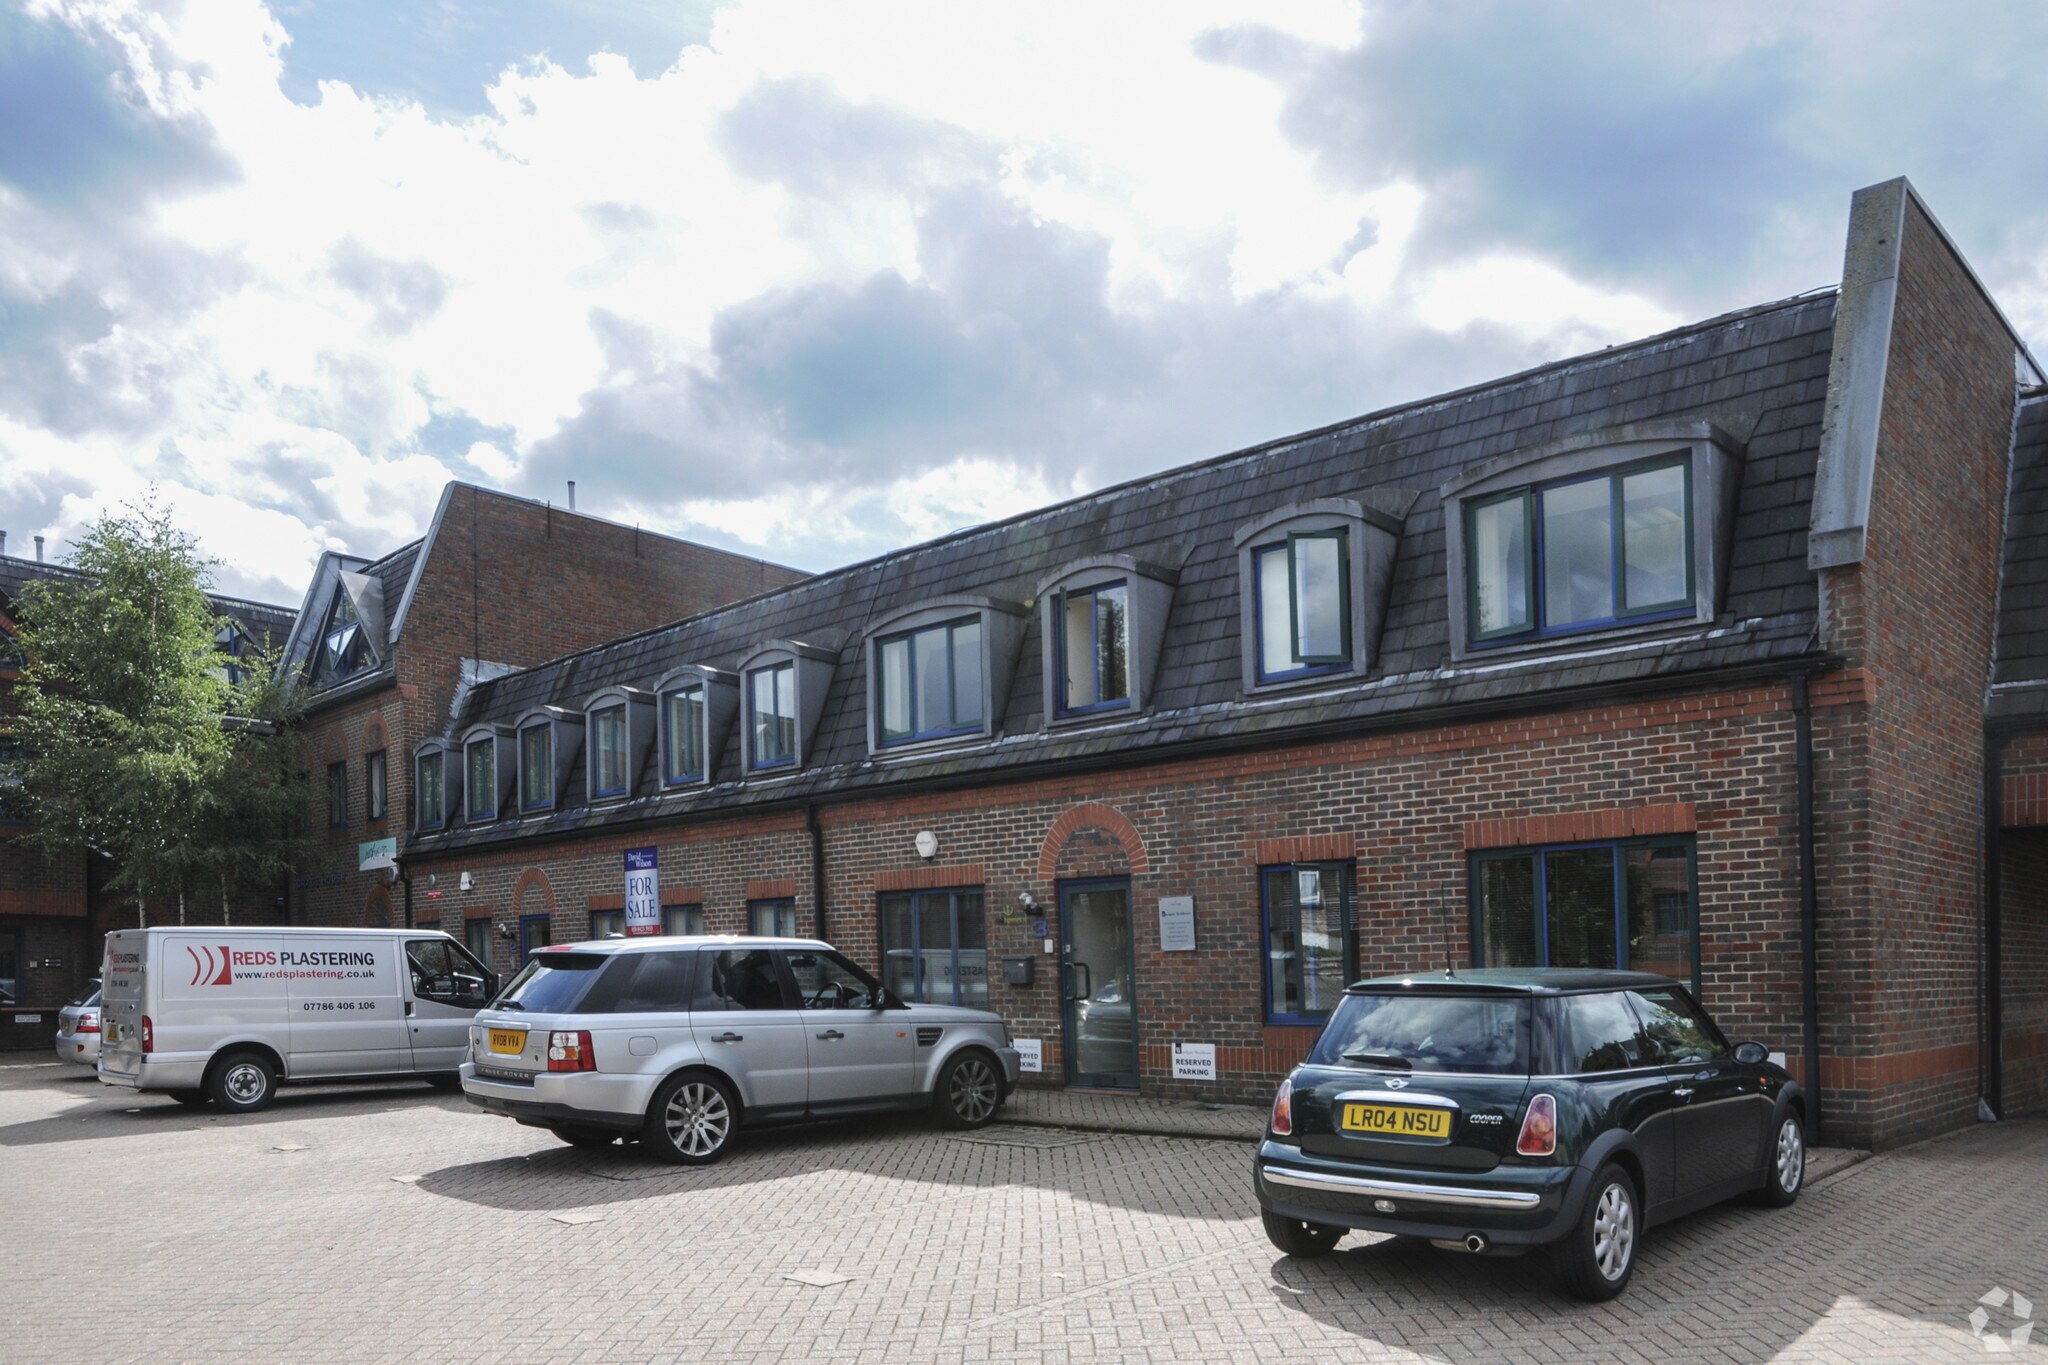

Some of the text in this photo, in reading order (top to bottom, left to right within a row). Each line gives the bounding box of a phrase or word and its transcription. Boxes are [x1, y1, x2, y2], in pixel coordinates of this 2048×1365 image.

[627, 851, 641, 862] David
[635, 859, 652, 868] Wilson
[629, 876, 653, 897] FOR
[627, 899, 656, 919] SALE
[1032, 918, 1049, 938] 3
[232, 951, 375, 967] REDS PLASTERING
[234, 969, 375, 980] www.redsplastering.co.uk
[303, 1001, 375, 1011] 07786 406 106
[1175, 1058, 1212, 1066] RESERVED
[504, 1069, 530, 1078] ROVER
[1178, 1068, 1209, 1076] PARKING
[1350, 1108, 1442, 1133] LR04 NSU
[1469, 1114, 1503, 1125] COOPER
